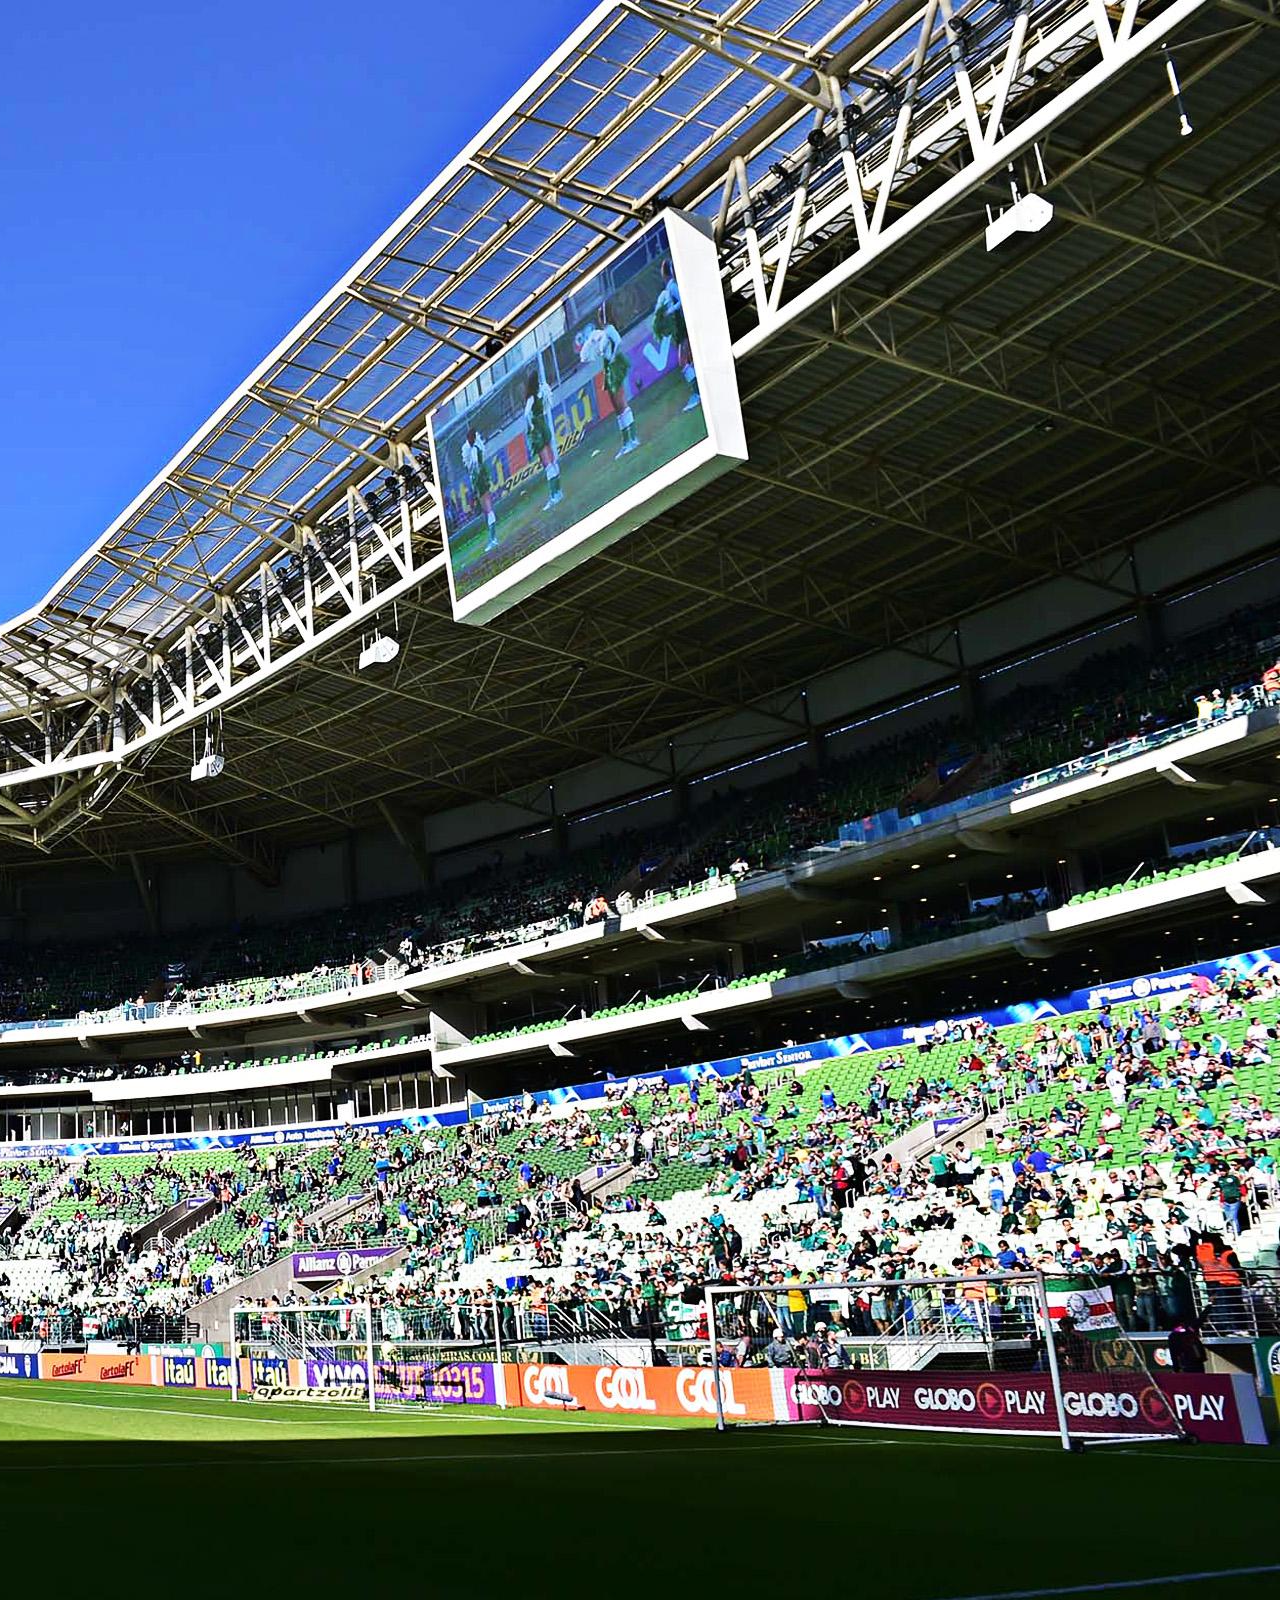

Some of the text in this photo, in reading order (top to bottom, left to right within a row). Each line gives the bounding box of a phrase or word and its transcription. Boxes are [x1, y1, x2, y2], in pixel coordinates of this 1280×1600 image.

[299, 1256, 336, 1272] Allianz
[165, 1358, 194, 1385] Itaú
[252, 1359, 287, 1387] Itaú
[431, 1366, 485, 1399] 10315
[523, 1365, 578, 1406] GOL
[595, 1367, 656, 1410] GOL
[676, 1368, 746, 1414] GOL
[790, 1384, 900, 1409] GLOBO PLAY
[914, 1387, 1045, 1415] GLOBO PLAY
[1063, 1391, 1224, 1421] GLOBO PLAY
